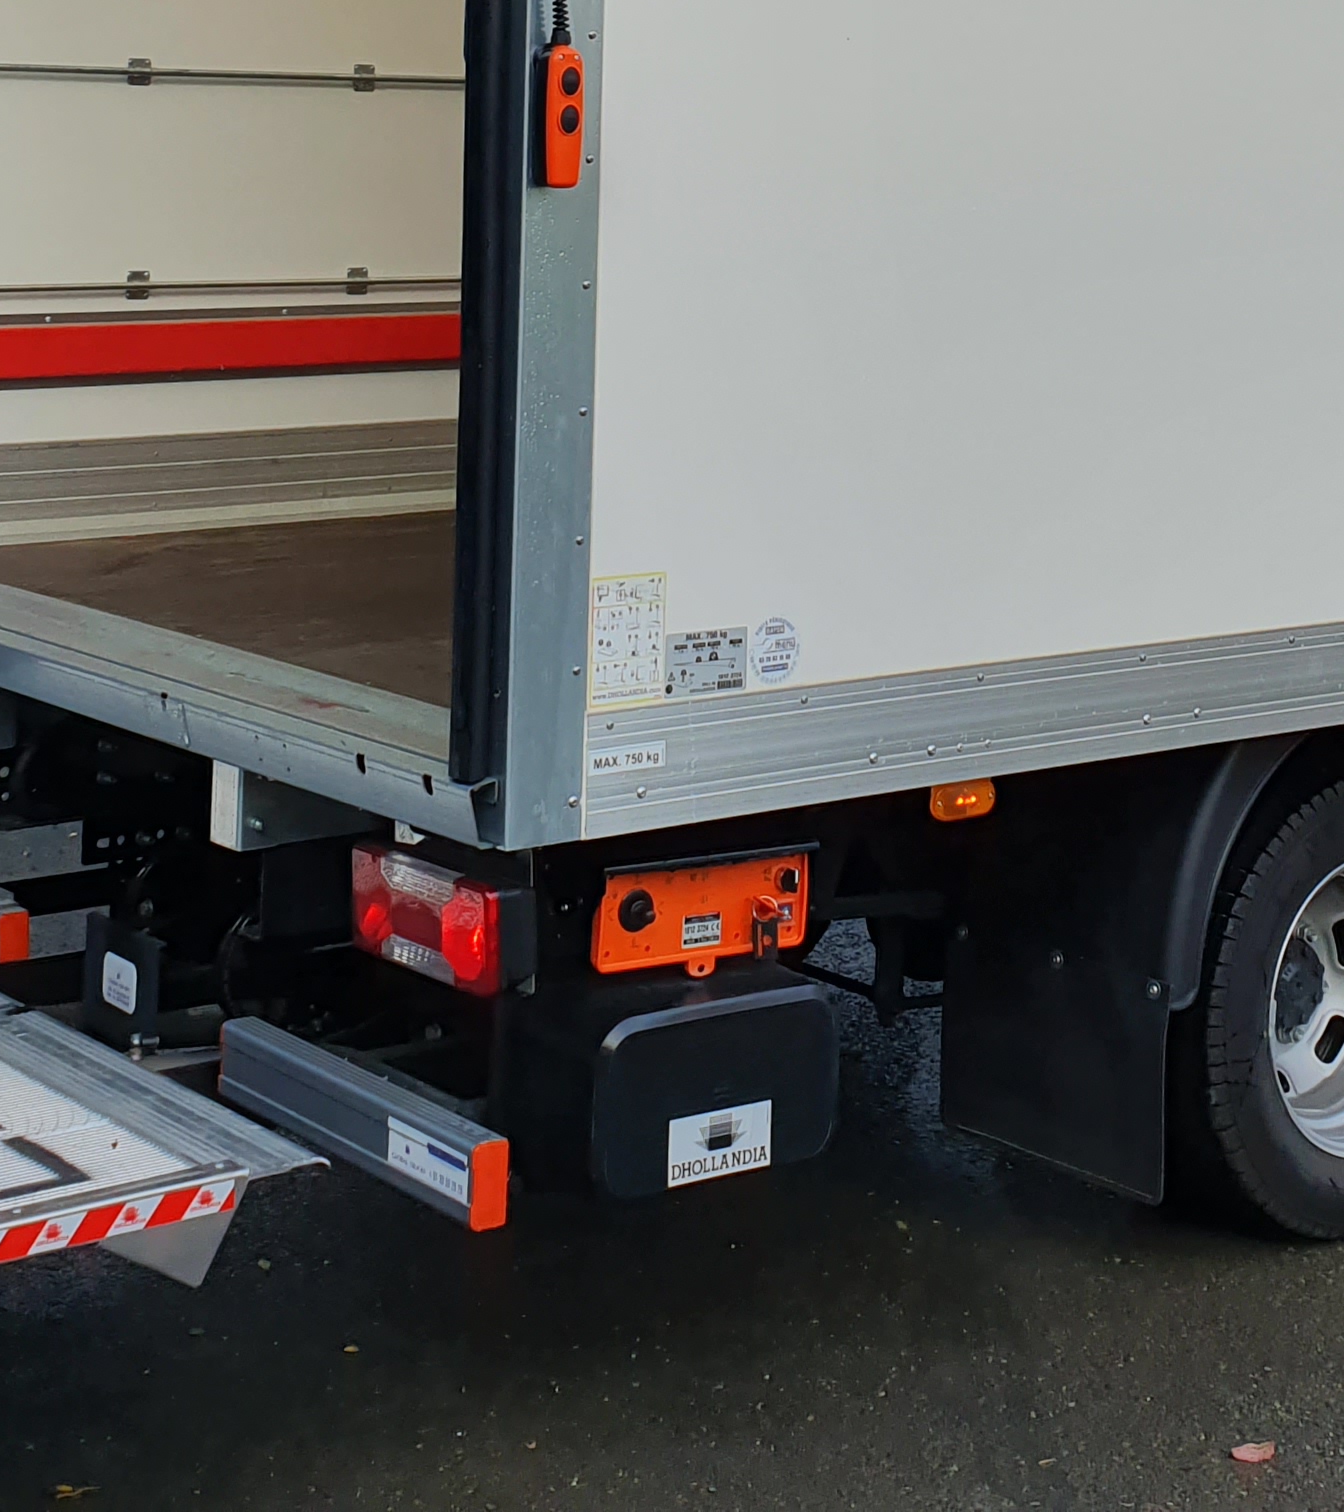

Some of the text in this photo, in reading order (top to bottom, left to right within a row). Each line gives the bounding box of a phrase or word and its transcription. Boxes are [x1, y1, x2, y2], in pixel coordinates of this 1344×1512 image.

[593, 751, 659, 769] MAX. 750 kg
[671, 1145, 768, 1181] DHOLLANDIA
